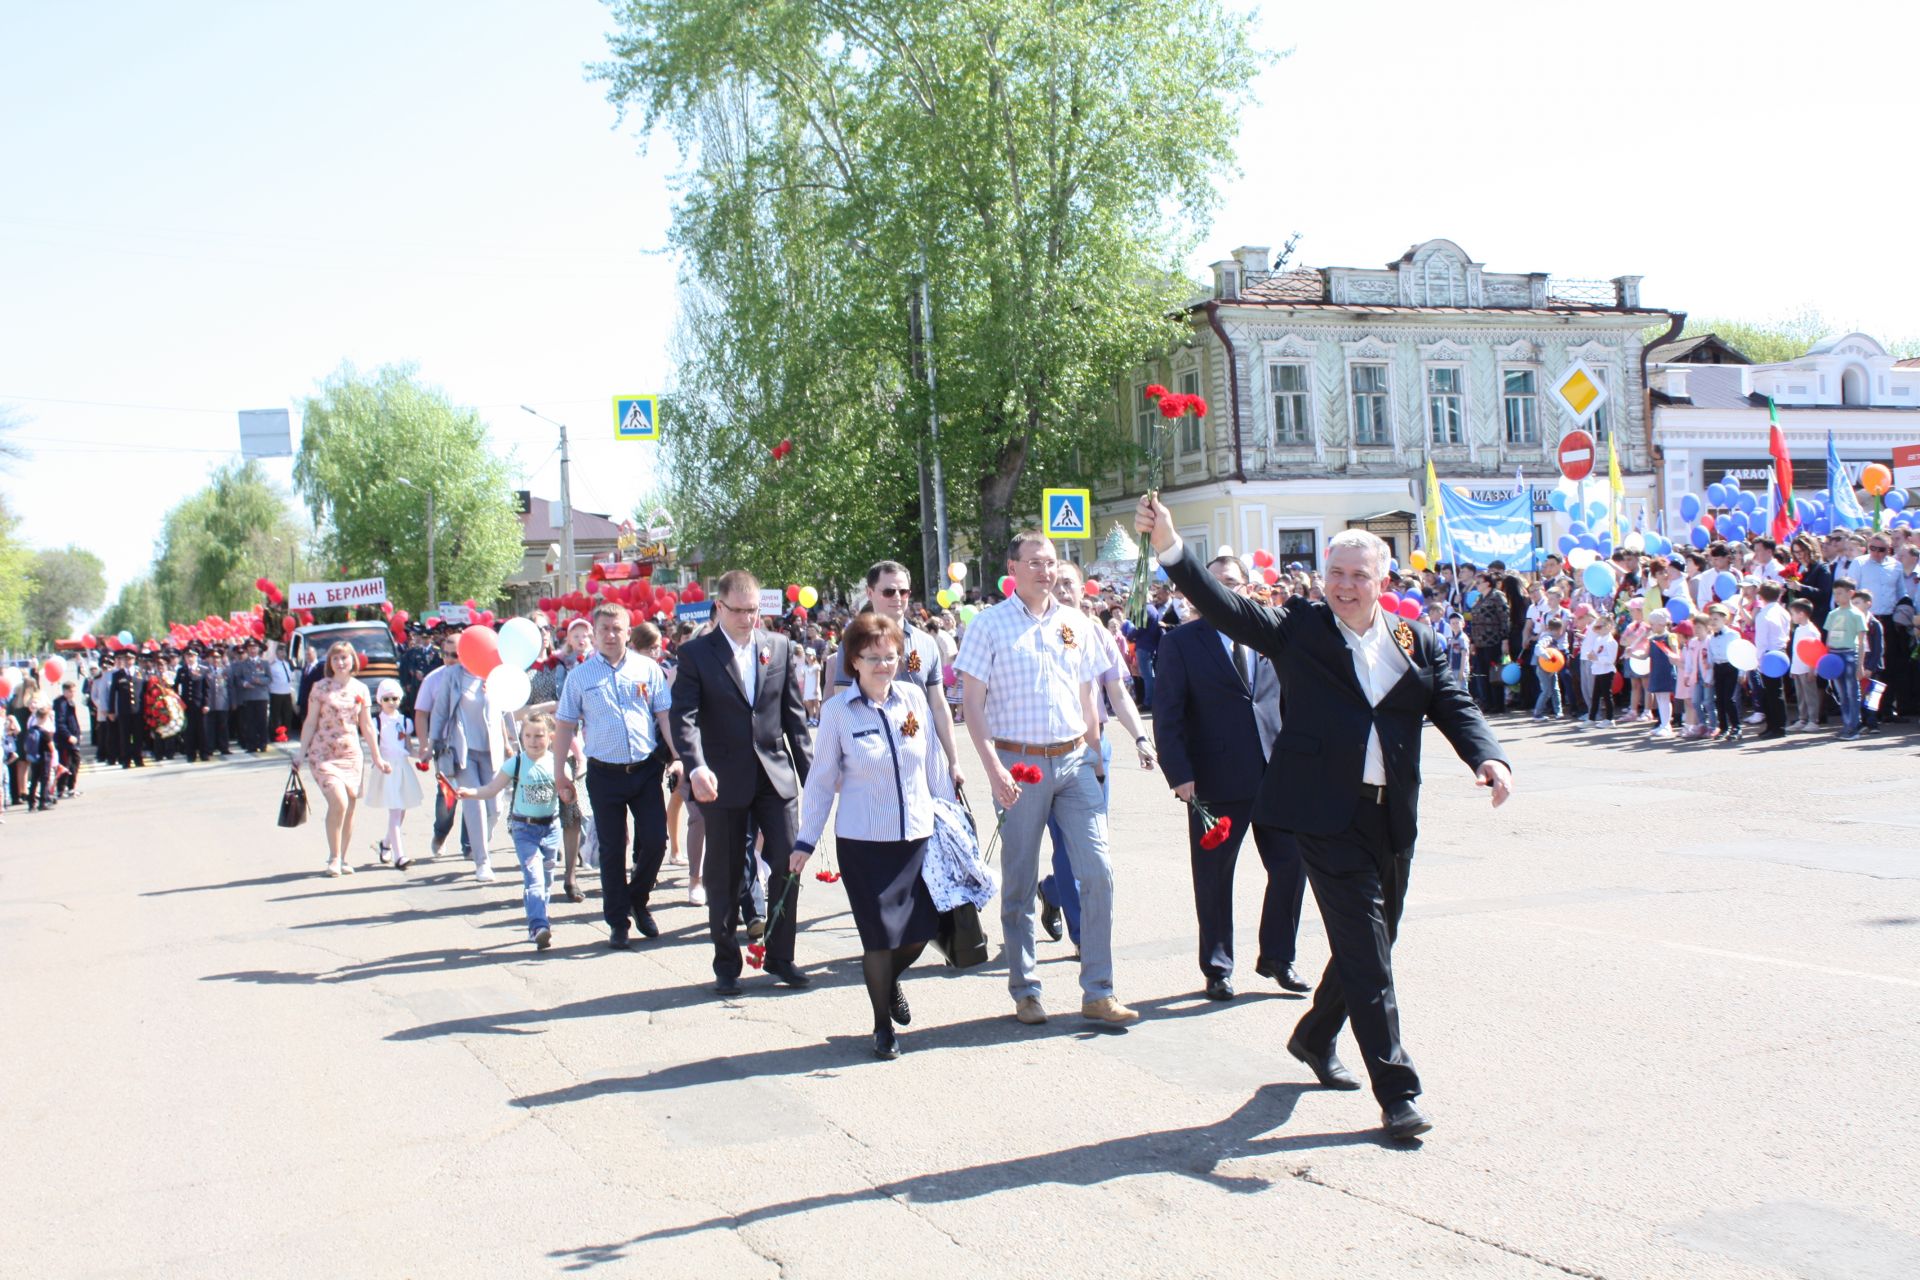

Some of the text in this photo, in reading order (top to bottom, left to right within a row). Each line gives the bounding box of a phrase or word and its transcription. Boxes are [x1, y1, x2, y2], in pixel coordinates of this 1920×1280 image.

[1725, 468, 1769, 479] KARAO
[298, 581, 383, 606] НА БЕРЛИН!
